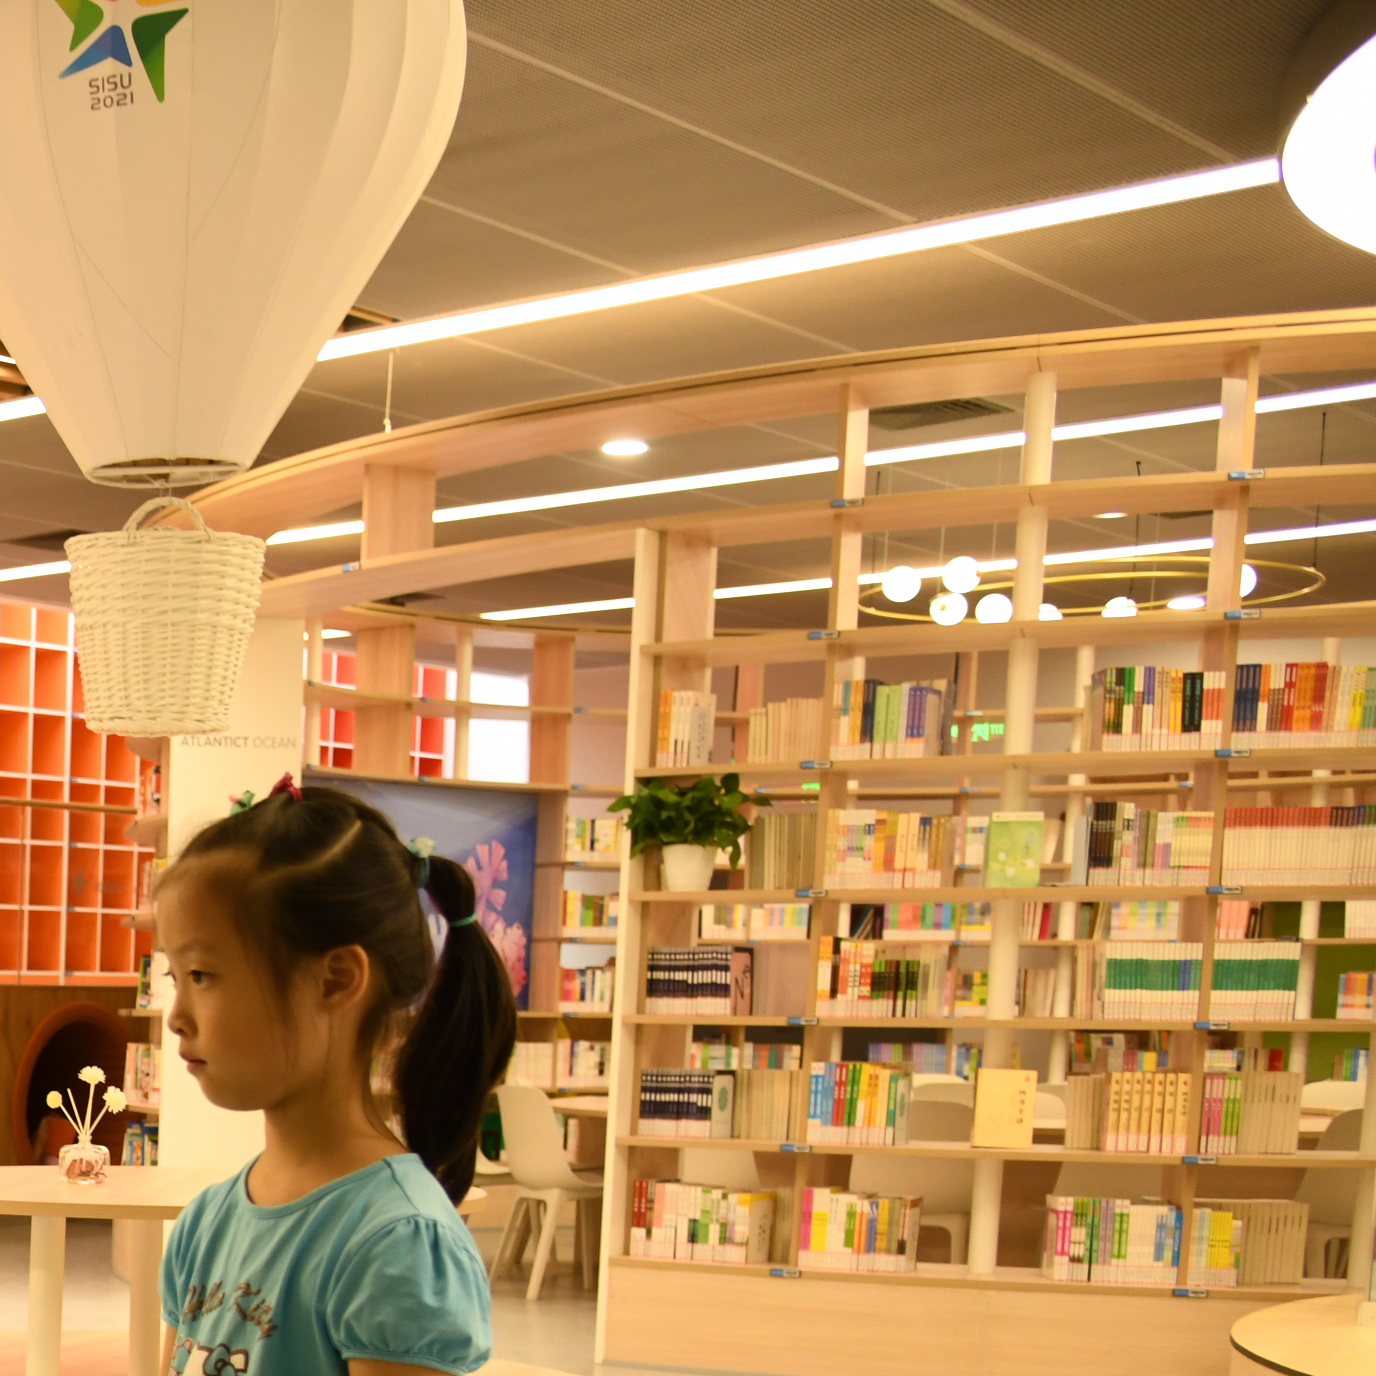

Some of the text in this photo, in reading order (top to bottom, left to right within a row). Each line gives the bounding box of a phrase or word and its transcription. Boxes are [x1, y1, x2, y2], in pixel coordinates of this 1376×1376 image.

[88, 72, 133, 96] SISU
[90, 92, 135, 111] 2021
[181, 735, 297, 749] ATLANTICT OCEAN
